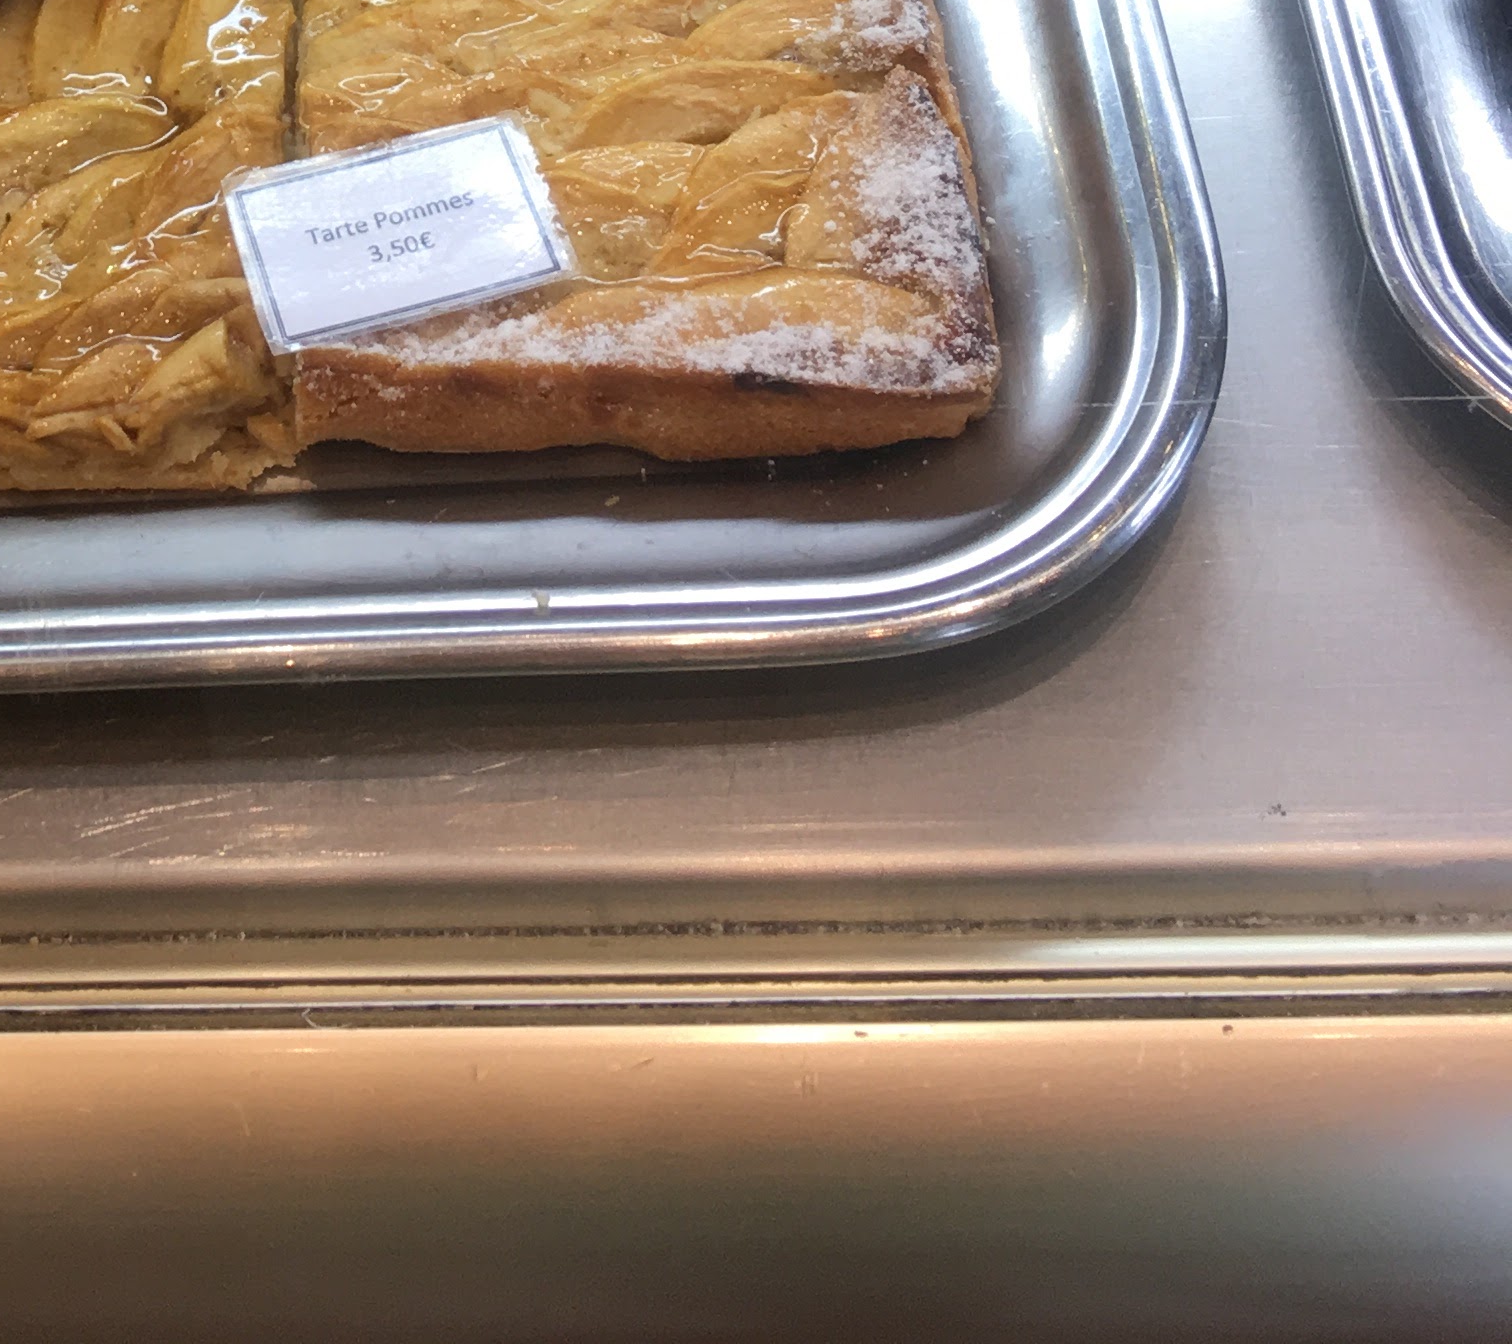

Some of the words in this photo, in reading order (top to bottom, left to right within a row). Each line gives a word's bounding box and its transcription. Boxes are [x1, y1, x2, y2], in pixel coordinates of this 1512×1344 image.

[304, 219, 369, 246] Tarte
[373, 190, 475, 230] Pommes
[367, 231, 436, 264] 3,50€
